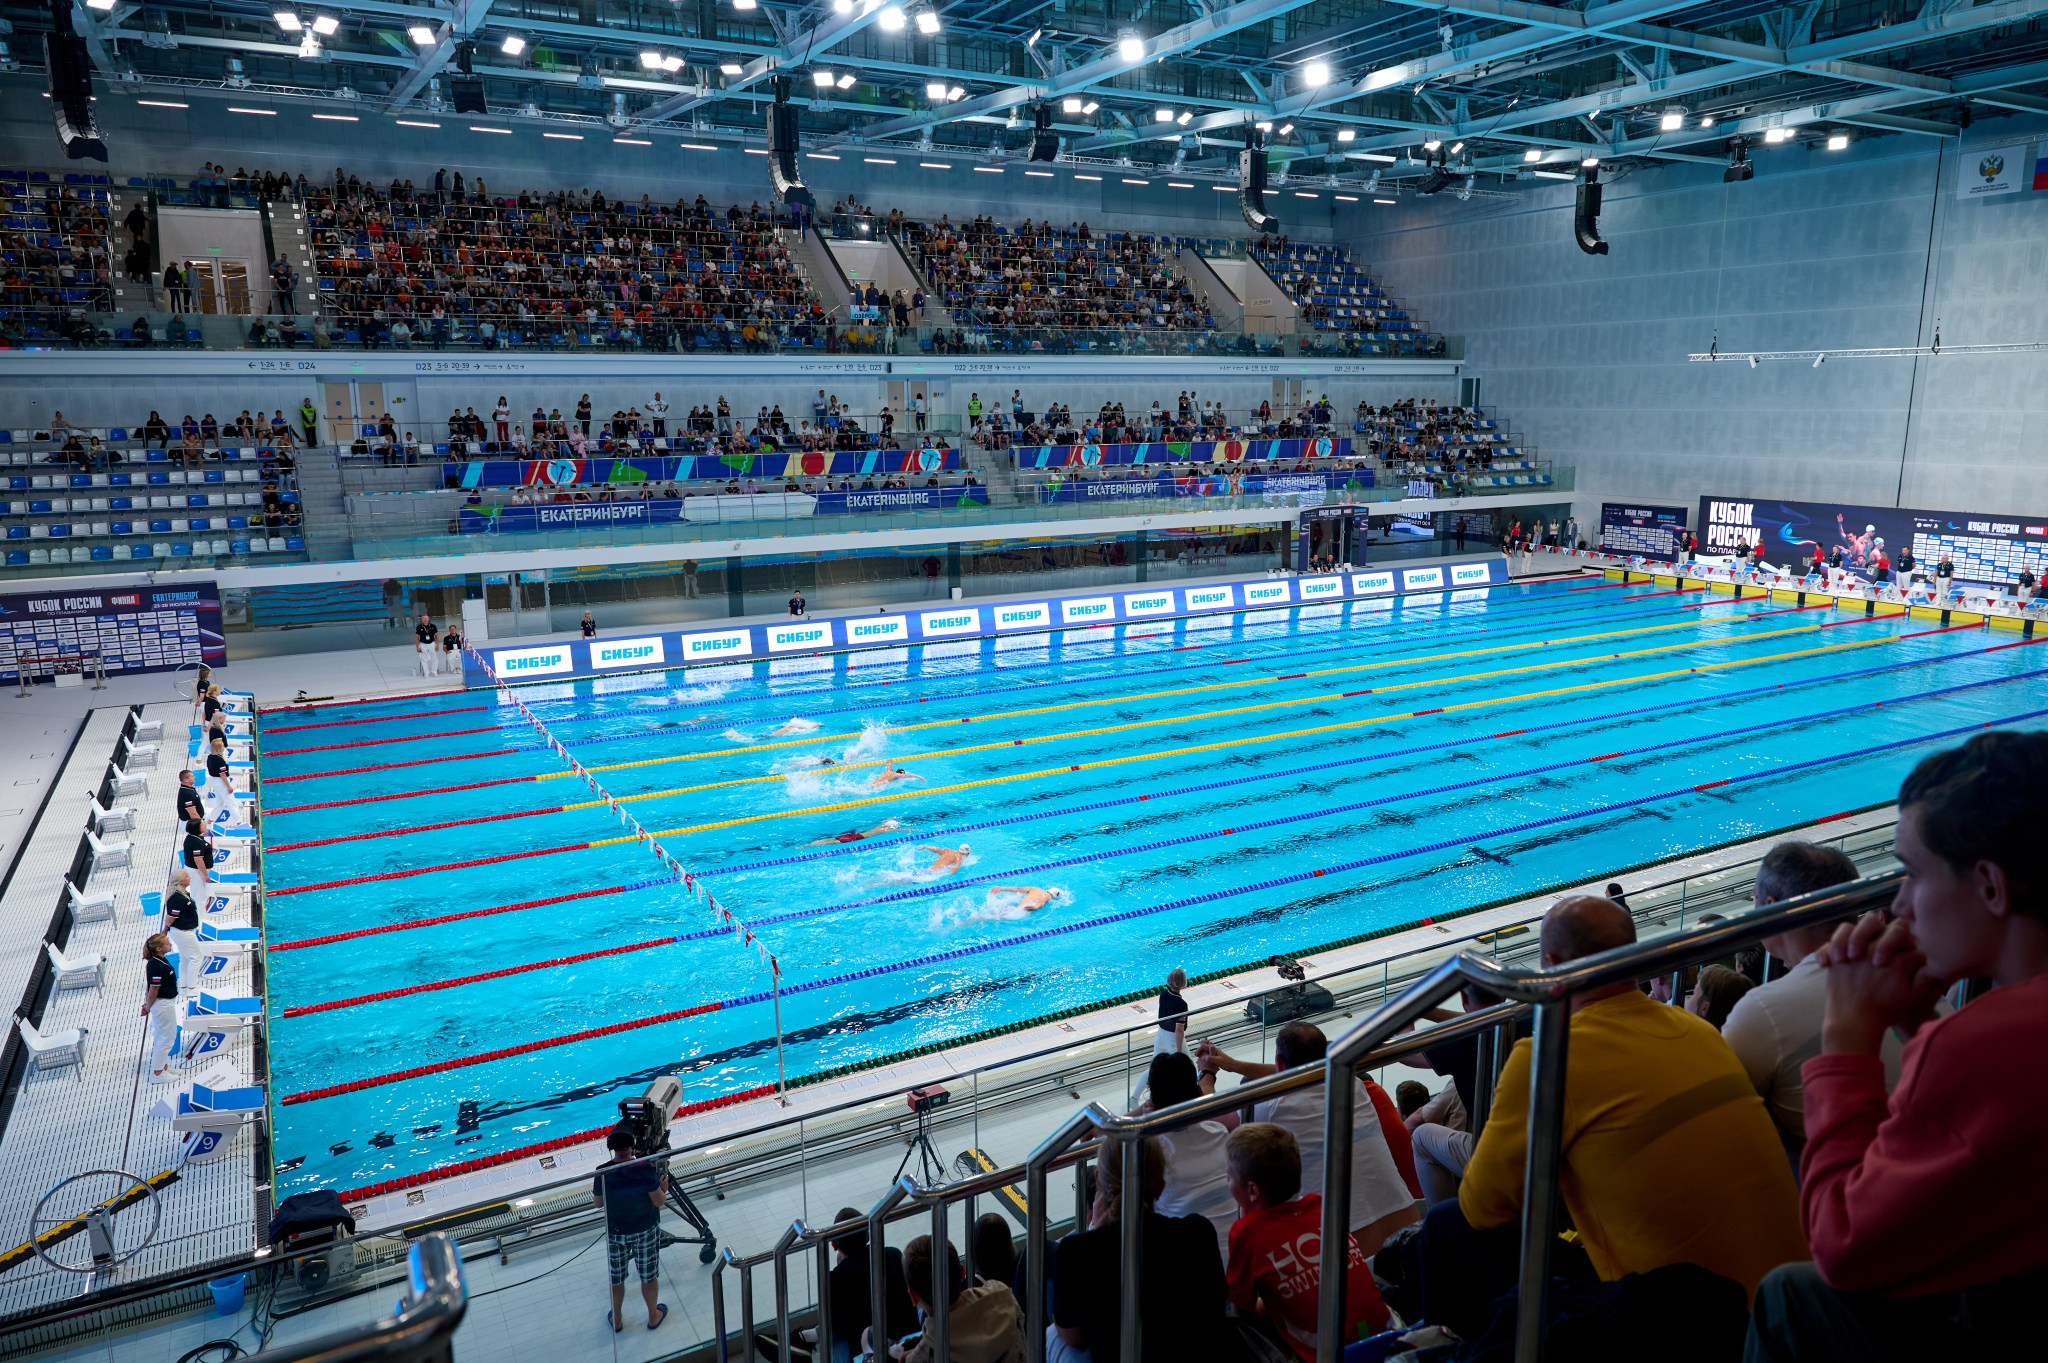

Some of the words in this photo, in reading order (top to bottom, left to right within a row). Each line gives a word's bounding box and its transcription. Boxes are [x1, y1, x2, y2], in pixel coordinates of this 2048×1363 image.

[298, 362, 315, 370] D24
[1087, 483, 1159, 496] ЕКАТЕРИНБУРГ
[847, 493, 929, 507] EKATERINBURG
[541, 505, 645, 522] ЕКАТЕРИНБУРГ
[1709, 501, 1754, 526] КУБОК
[1967, 521, 1990, 532] КУБОК
[1991, 523, 2020, 534] РОССИИ
[1707, 524, 1761, 549] РОССИИ
[1409, 573, 1437, 583] СИБУР
[1457, 569, 1484, 579] СИБУР
[1306, 583, 1337, 593] СИБУР
[1358, 578, 1388, 588] СИБУР
[1192, 592, 1226, 604] СИБУР
[1250, 588, 1282, 599] СИБУР
[28, 599, 61, 613] КУБОК
[64, 596, 102, 610] РОССИИ
[1069, 604, 1107, 616] СИБУР
[1132, 598, 1166, 610] СИБУР
[930, 616, 972, 629] СИБУР
[1002, 610, 1042, 623] СИБУР
[854, 623, 898, 636] СИБУР
[777, 630, 823, 644] СИБУР
[692, 637, 741, 652] СИБУР
[601, 646, 653, 661] СИБУР
[506, 654, 561, 671] СИБУР
[220, 812, 227, 820] 4
[218, 852, 225, 860] 5
[216, 900, 224, 909] 6
[214, 960, 222, 970] 7
[209, 1036, 219, 1048] 8
[203, 1137, 214, 1149] 9
